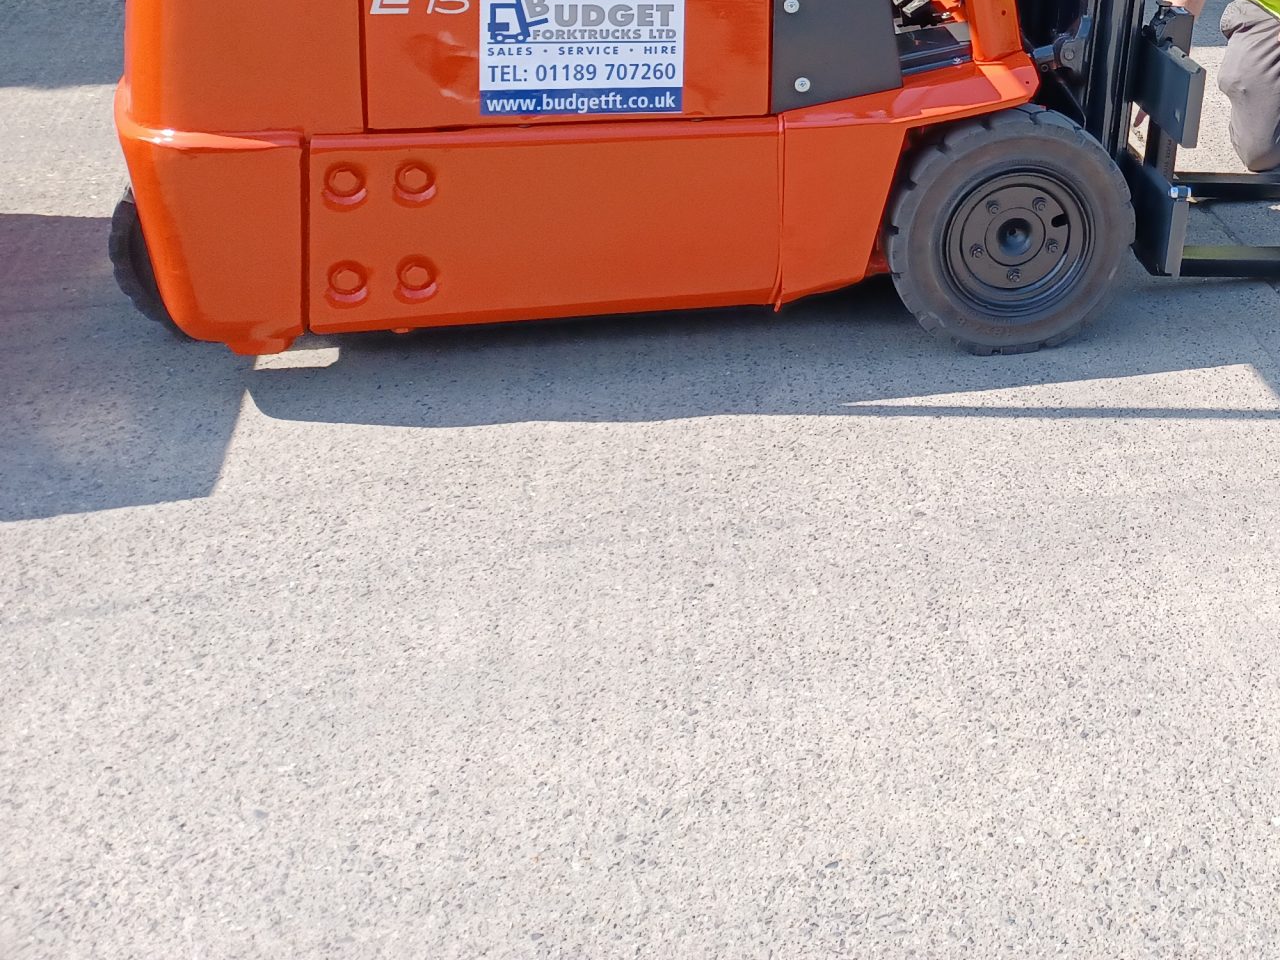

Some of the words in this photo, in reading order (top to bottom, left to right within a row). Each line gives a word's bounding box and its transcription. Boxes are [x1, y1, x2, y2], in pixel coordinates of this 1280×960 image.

[532, 29, 642, 40] FORKTRUCKS
[649, 29, 677, 40] LTD
[487, 47, 533, 56] SALES
[558, 46, 619, 56] SERVICE
[644, 46, 677, 55] HIRE
[488, 65, 528, 82] TEL:
[535, 64, 597, 82] 01189
[604, 63, 676, 81] 707260
[486, 92, 676, 113] www.budgetft.co.uk
